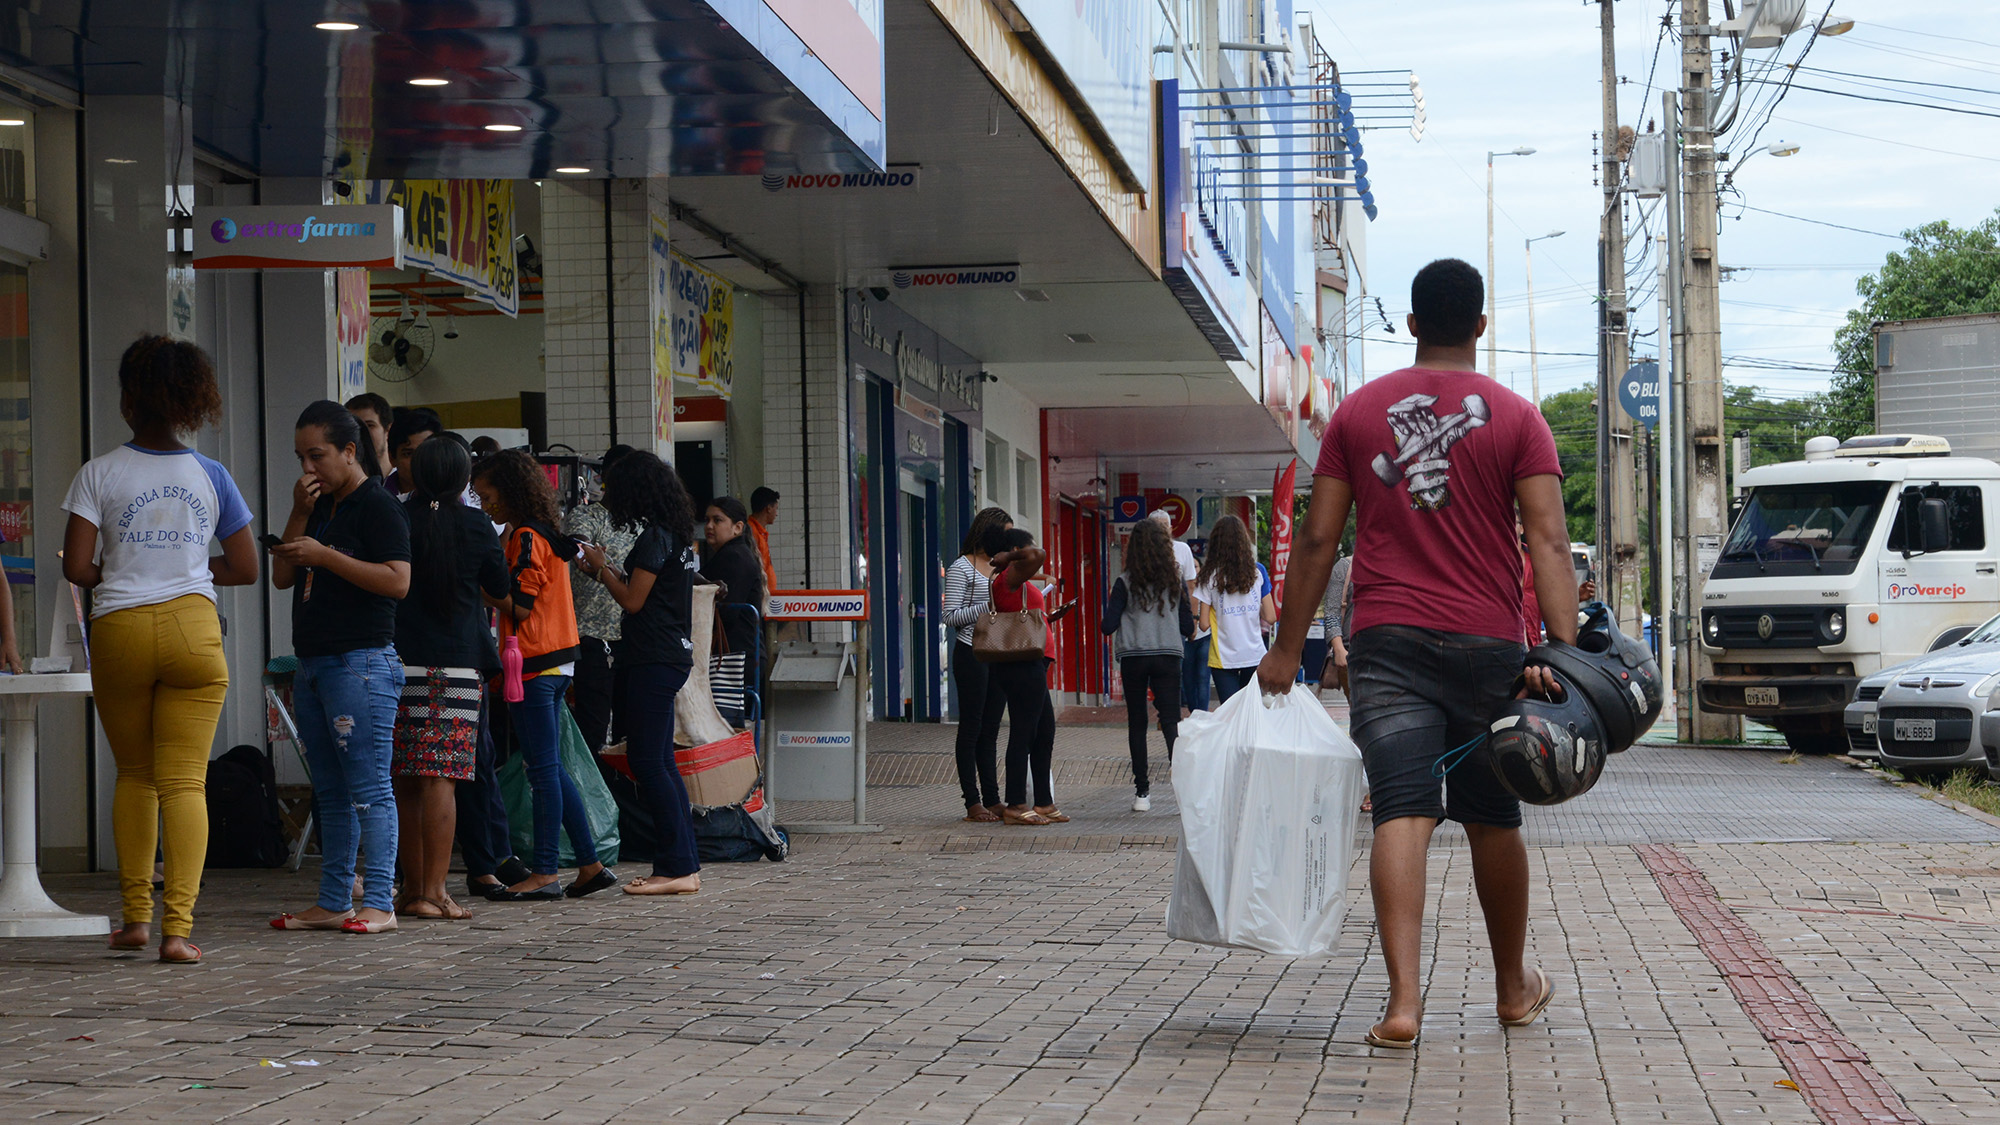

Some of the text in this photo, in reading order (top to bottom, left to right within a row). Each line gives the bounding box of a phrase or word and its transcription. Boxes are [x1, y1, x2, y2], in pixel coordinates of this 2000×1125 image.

[240, 216, 376, 243] extrafarma
[1640, 405, 1657, 417] 004
[118, 485, 209, 531] ESCOLA ESTADUAL
[119, 530, 206, 546] VALE DO SOL
